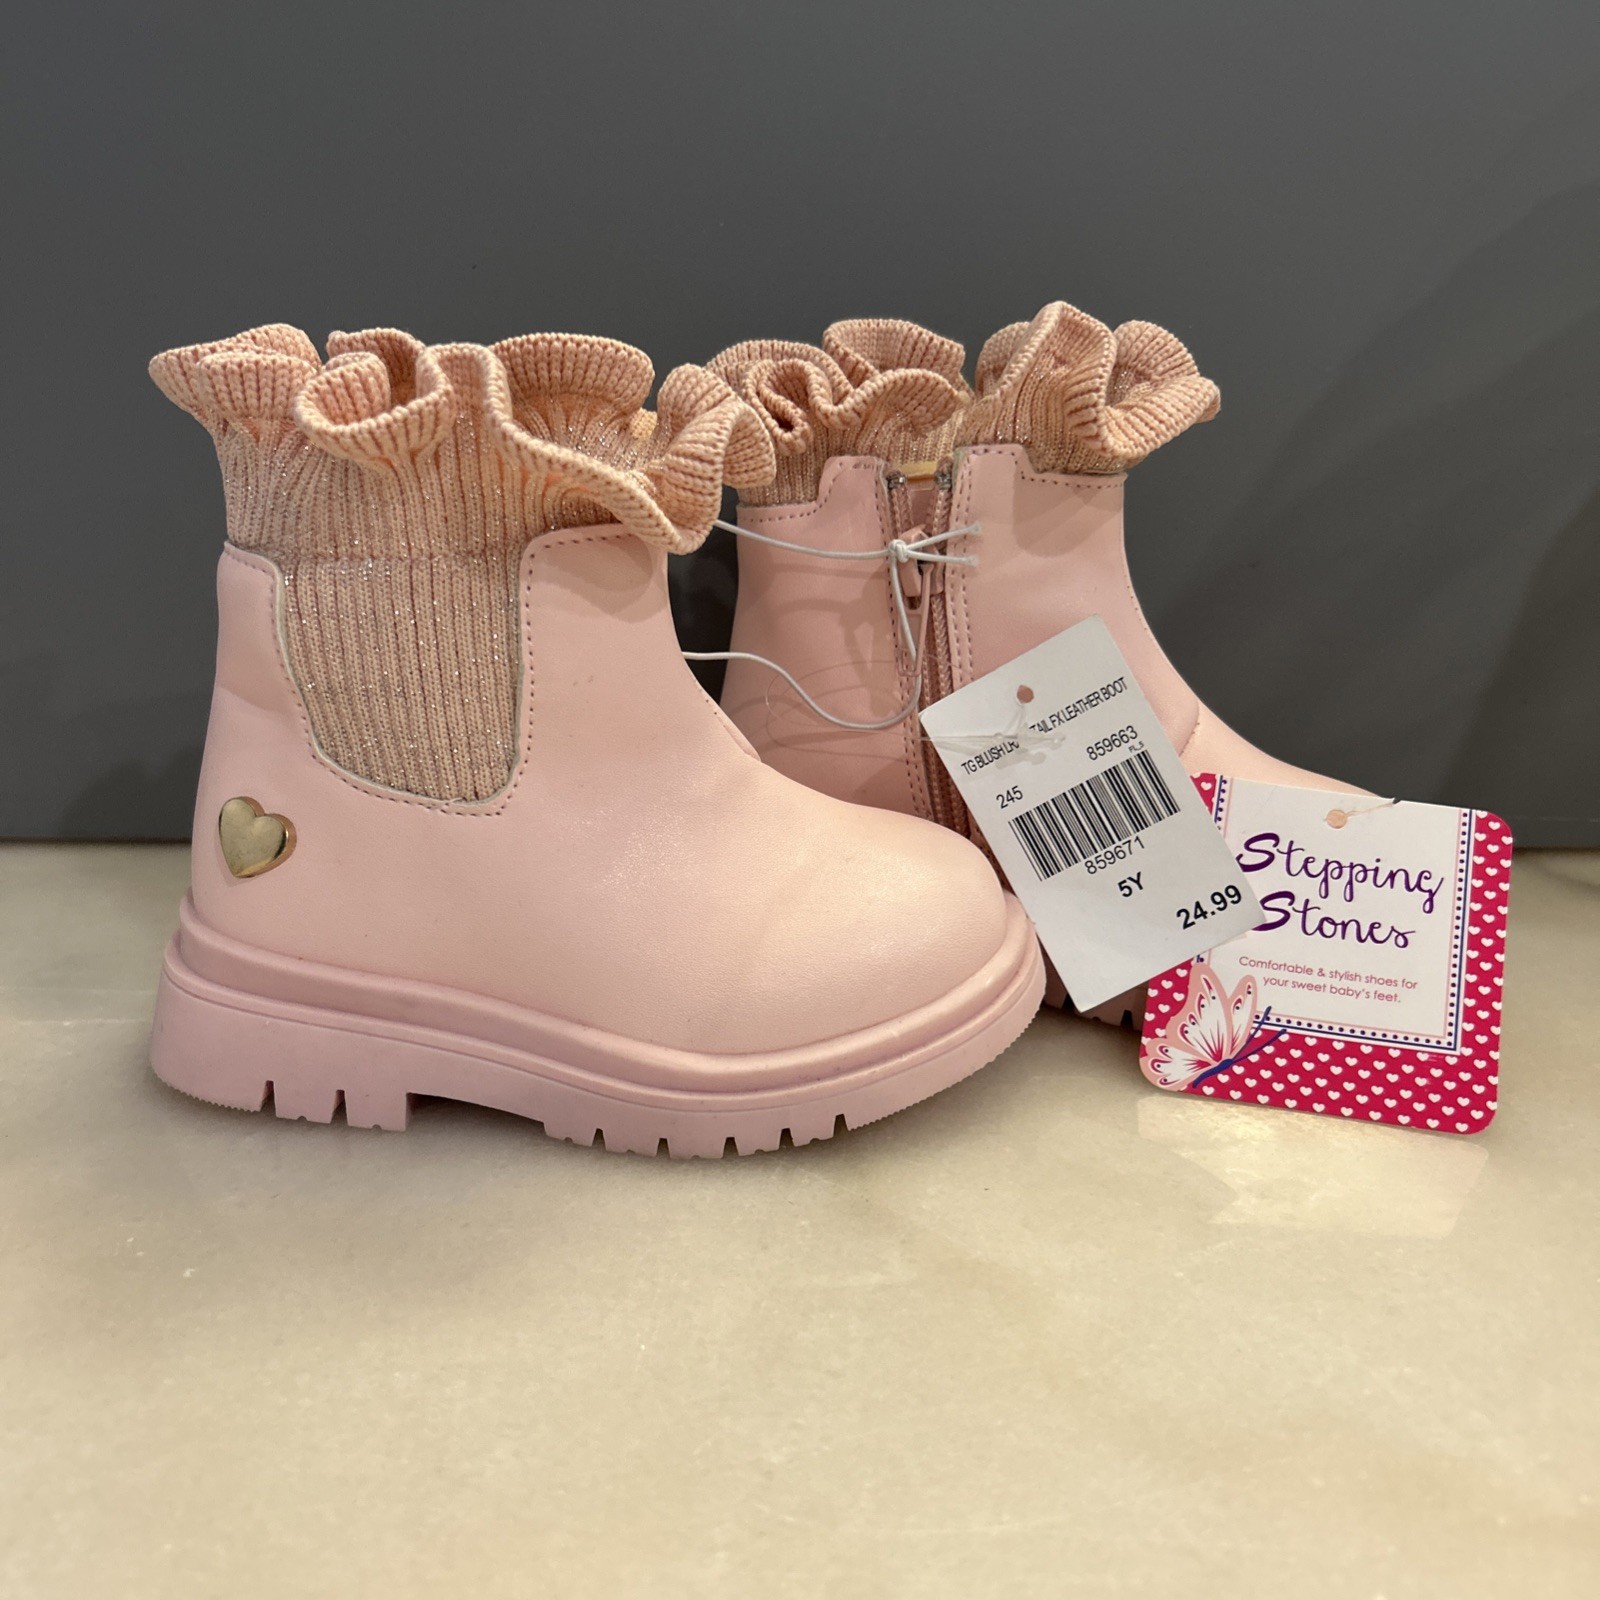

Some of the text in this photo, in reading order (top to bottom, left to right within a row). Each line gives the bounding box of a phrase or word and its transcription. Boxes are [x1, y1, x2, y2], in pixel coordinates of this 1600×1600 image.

[961, 759, 977, 775] TG
[974, 745, 1005, 769] BLUSH
[1049, 711, 1065, 728] FX
[1061, 691, 1104, 721] LEATHER
[1100, 677, 1127, 700] BOOT
[1086, 725, 1138, 761] 859663
[996, 785, 1023, 809] 245
[1084, 836, 1145, 874] 859671
[1236, 832, 1444, 914] Stepping
[1118, 871, 1144, 897] 5Y
[1176, 885, 1242, 930] 24.99
[1251, 891, 1416, 949] Stones
[1239, 956, 1418, 990] Comfortable & stylish shoes for
[1263, 976, 1401, 1003] your sweet baby's feet.
